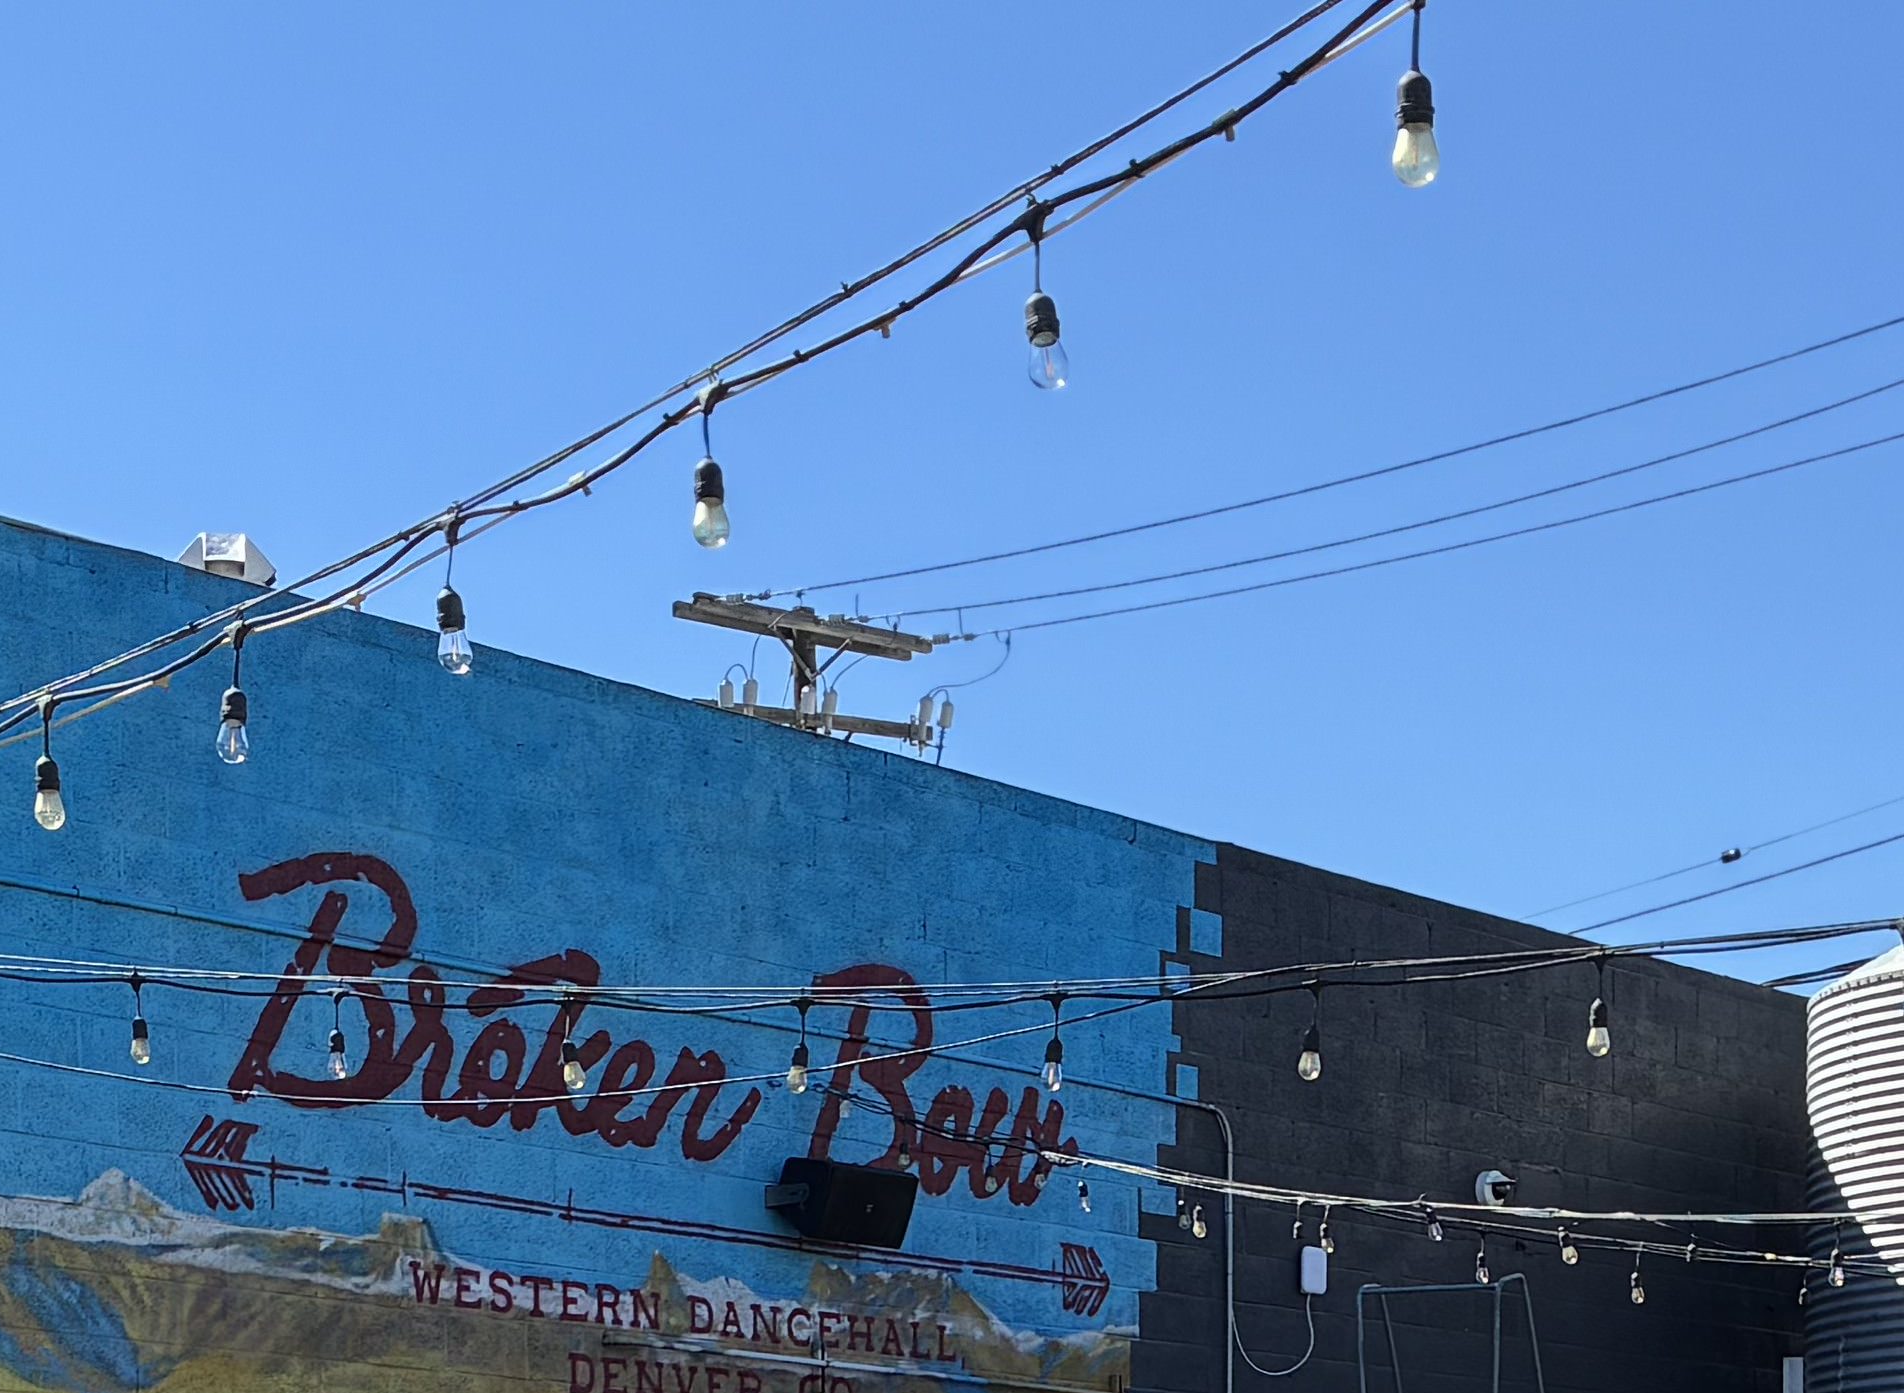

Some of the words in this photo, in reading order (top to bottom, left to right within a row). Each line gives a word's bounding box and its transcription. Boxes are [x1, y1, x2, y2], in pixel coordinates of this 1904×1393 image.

[228, 851, 761, 1161] Broken
[810, 963, 1074, 1206] Bow
[409, 1261, 660, 1329] WESTERN
